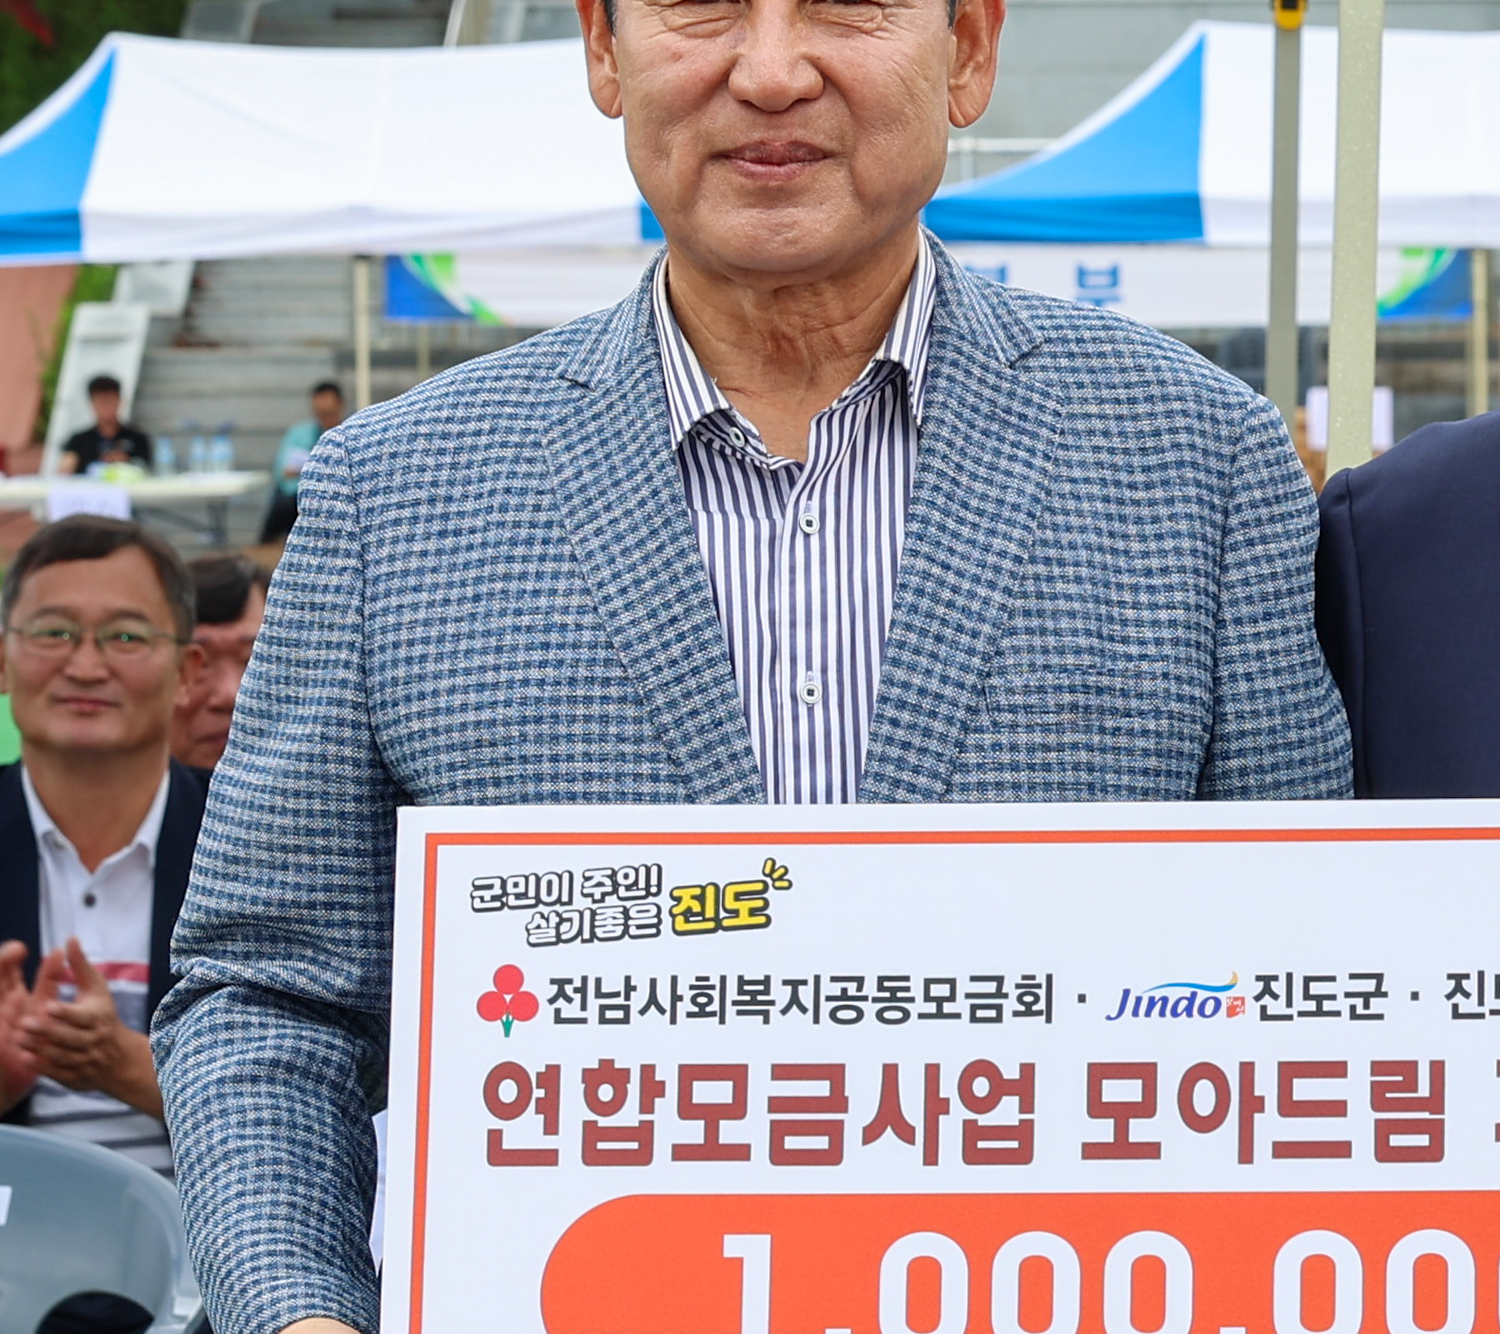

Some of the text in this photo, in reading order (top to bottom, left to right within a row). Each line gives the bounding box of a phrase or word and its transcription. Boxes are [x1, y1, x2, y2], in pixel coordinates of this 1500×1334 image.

[470, 863, 662, 912] 군민이 주인!
[669, 879, 772, 937] 진도
[525, 902, 662, 947] 살기좋은
[547, 973, 1055, 1028] 전남사회복지공동모금회
[1104, 986, 1223, 1021] Jindo
[1252, 971, 1391, 1023] 진도군
[482, 1058, 1038, 1169] 연합모금사업
[1081, 1059, 1448, 1167] 모아드림
